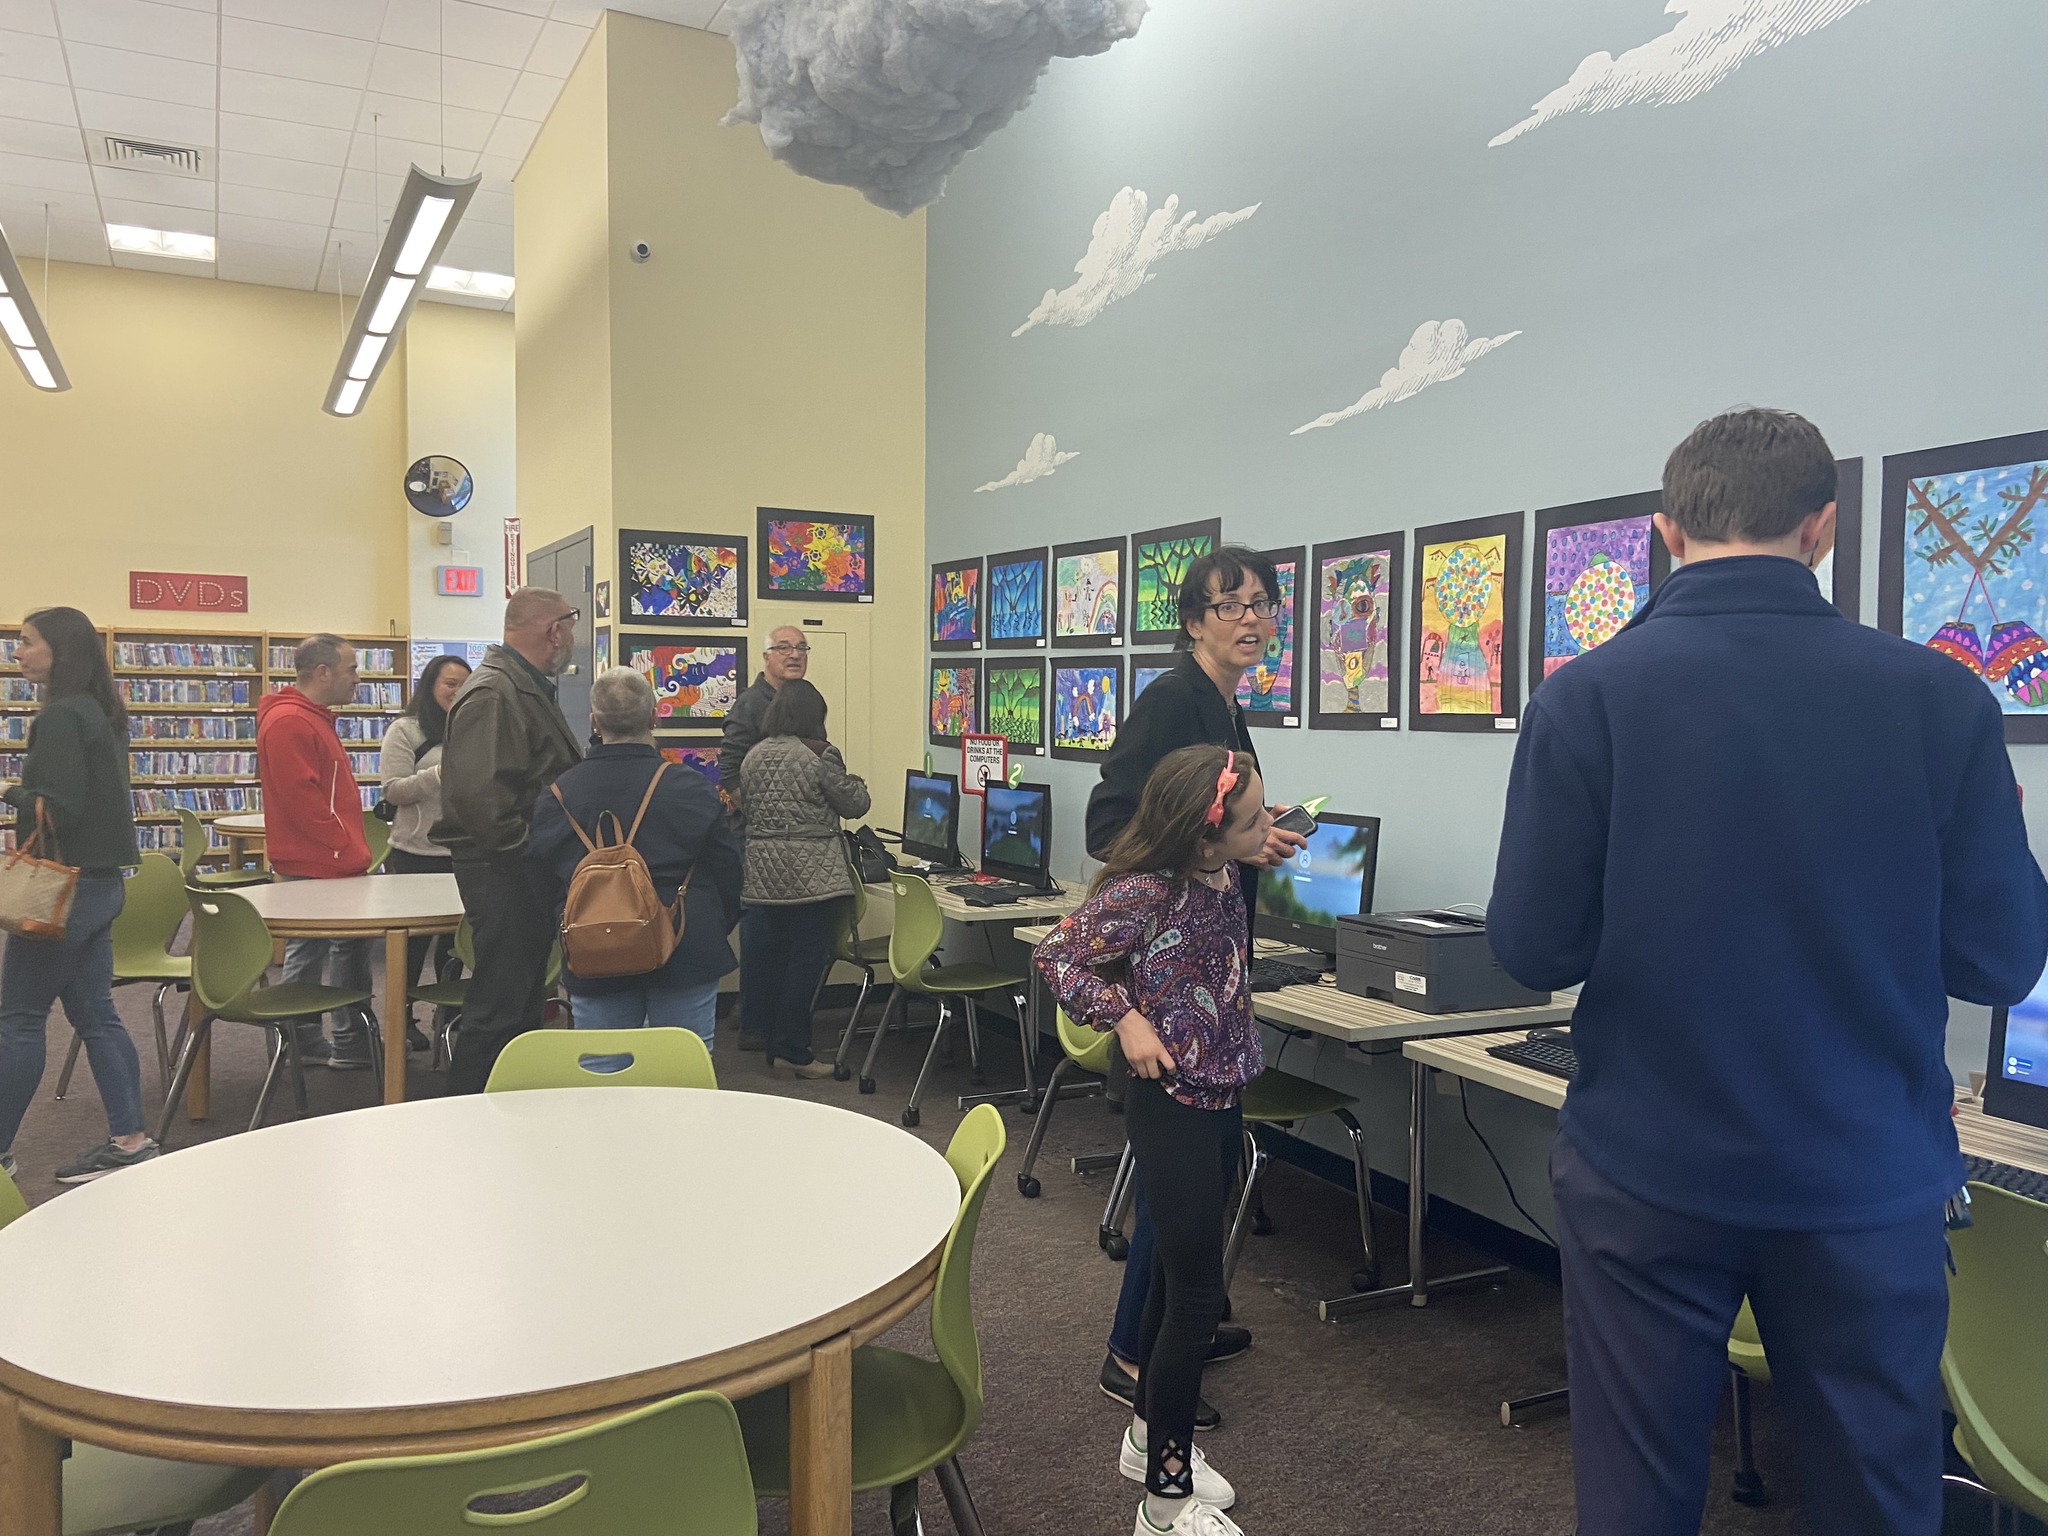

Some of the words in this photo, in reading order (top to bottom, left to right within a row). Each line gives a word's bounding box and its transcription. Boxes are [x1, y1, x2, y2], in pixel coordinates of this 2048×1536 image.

[505, 524, 519, 532] FIRE
[445, 568, 477, 592] EXIT
[136, 578, 243, 608] DVDs
[967, 746, 985, 755] DRINKS
[993, 748, 1003, 756] THE
[970, 755, 1000, 764] COMPUTERS
[1009, 763, 1021, 785] 2
